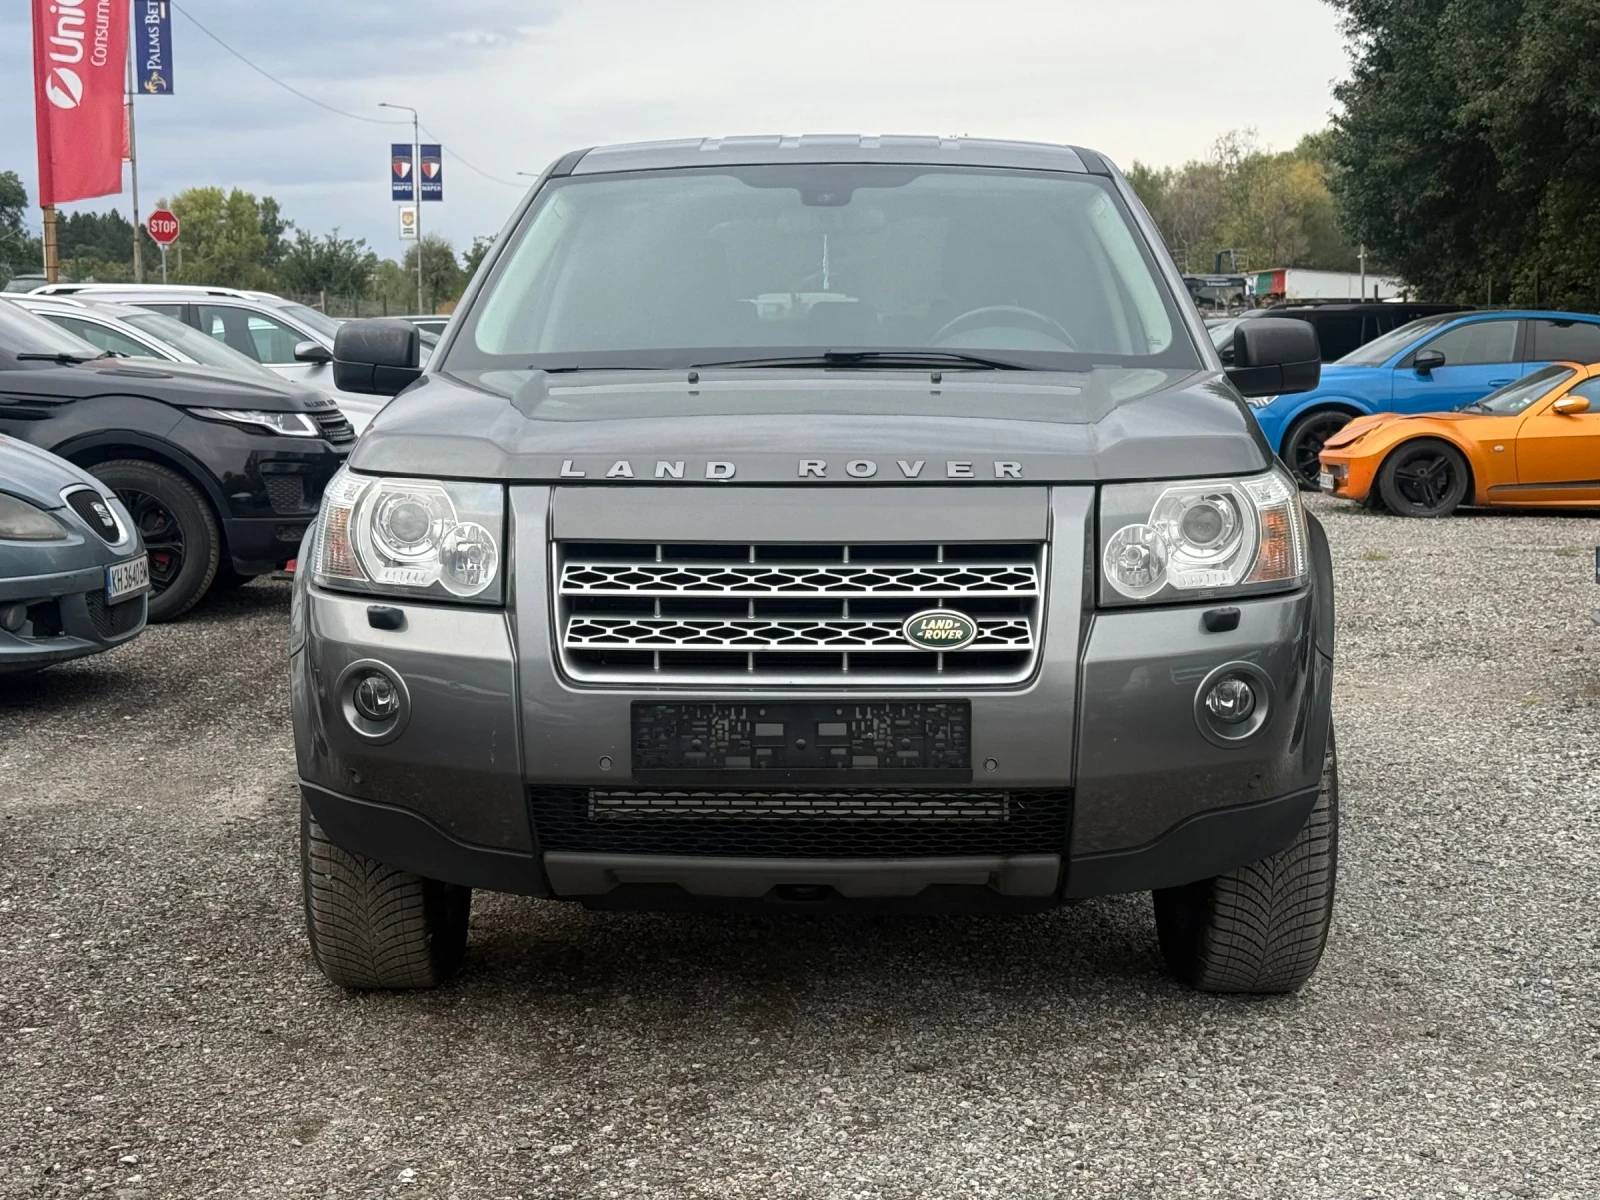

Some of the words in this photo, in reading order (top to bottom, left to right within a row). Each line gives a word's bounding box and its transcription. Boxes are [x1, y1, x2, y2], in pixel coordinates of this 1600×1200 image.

[145, 0, 160, 25] BET
[147, 26, 162, 70] PALMS
[151, 219, 176, 233] STOP
[560, 460, 736, 480] LAND
[798, 459, 1023, 478] ROVER
